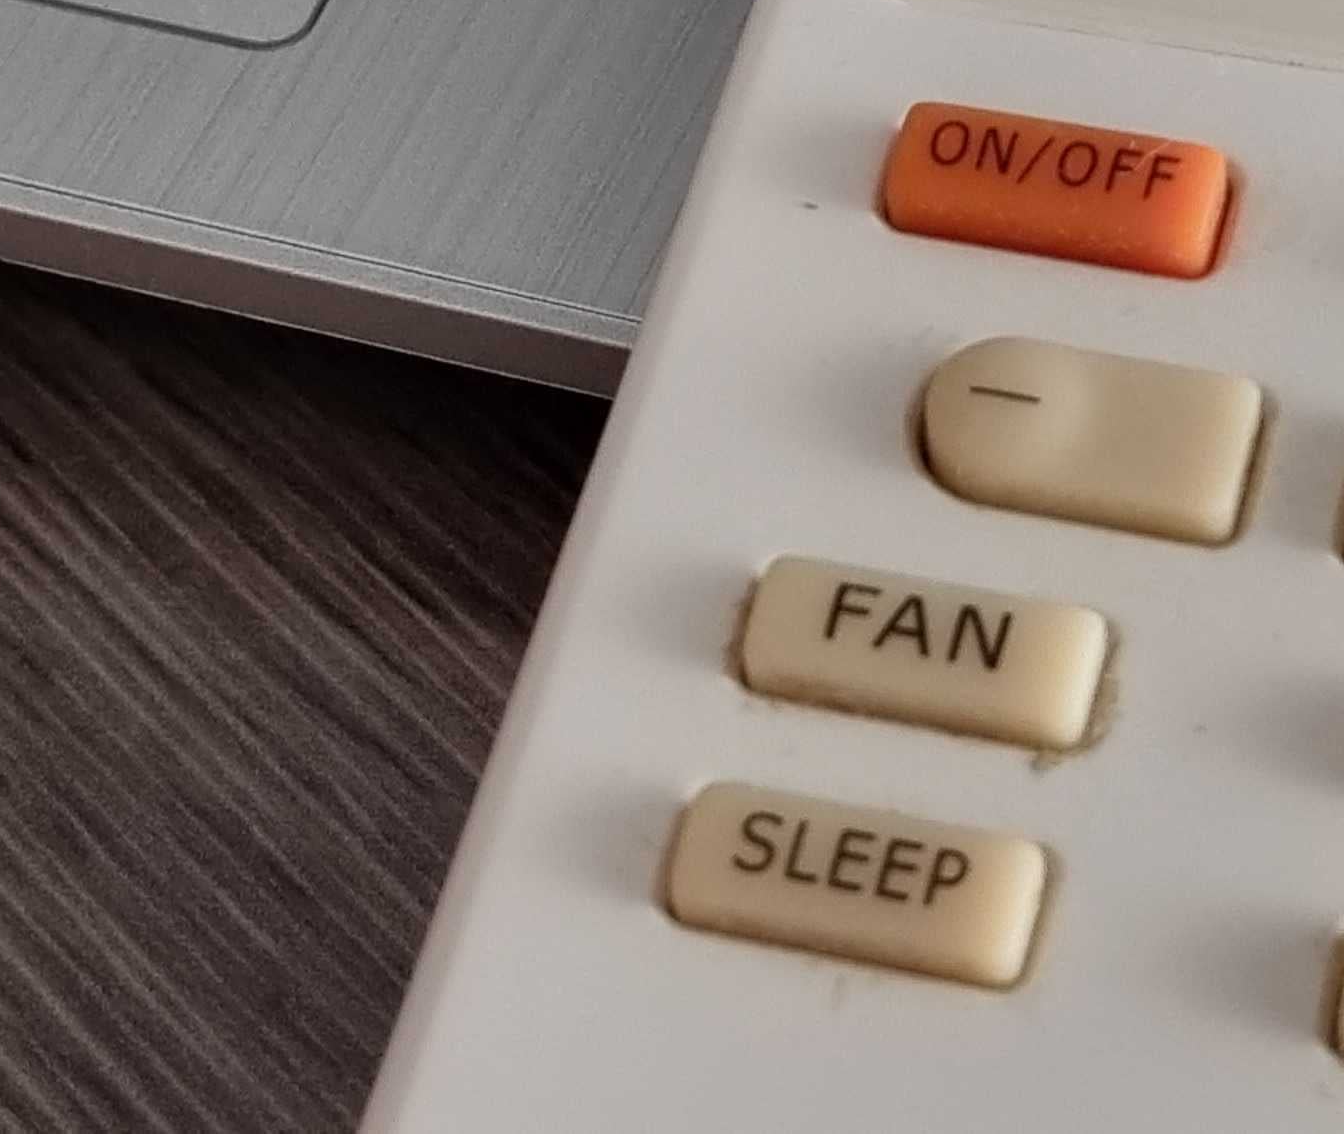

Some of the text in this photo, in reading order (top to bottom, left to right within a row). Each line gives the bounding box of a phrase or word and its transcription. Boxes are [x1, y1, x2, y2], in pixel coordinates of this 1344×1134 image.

[929, 120, 1182, 198] ON/OFF
[824, 582, 1014, 671] FAN
[732, 811, 972, 905] SLEEP
